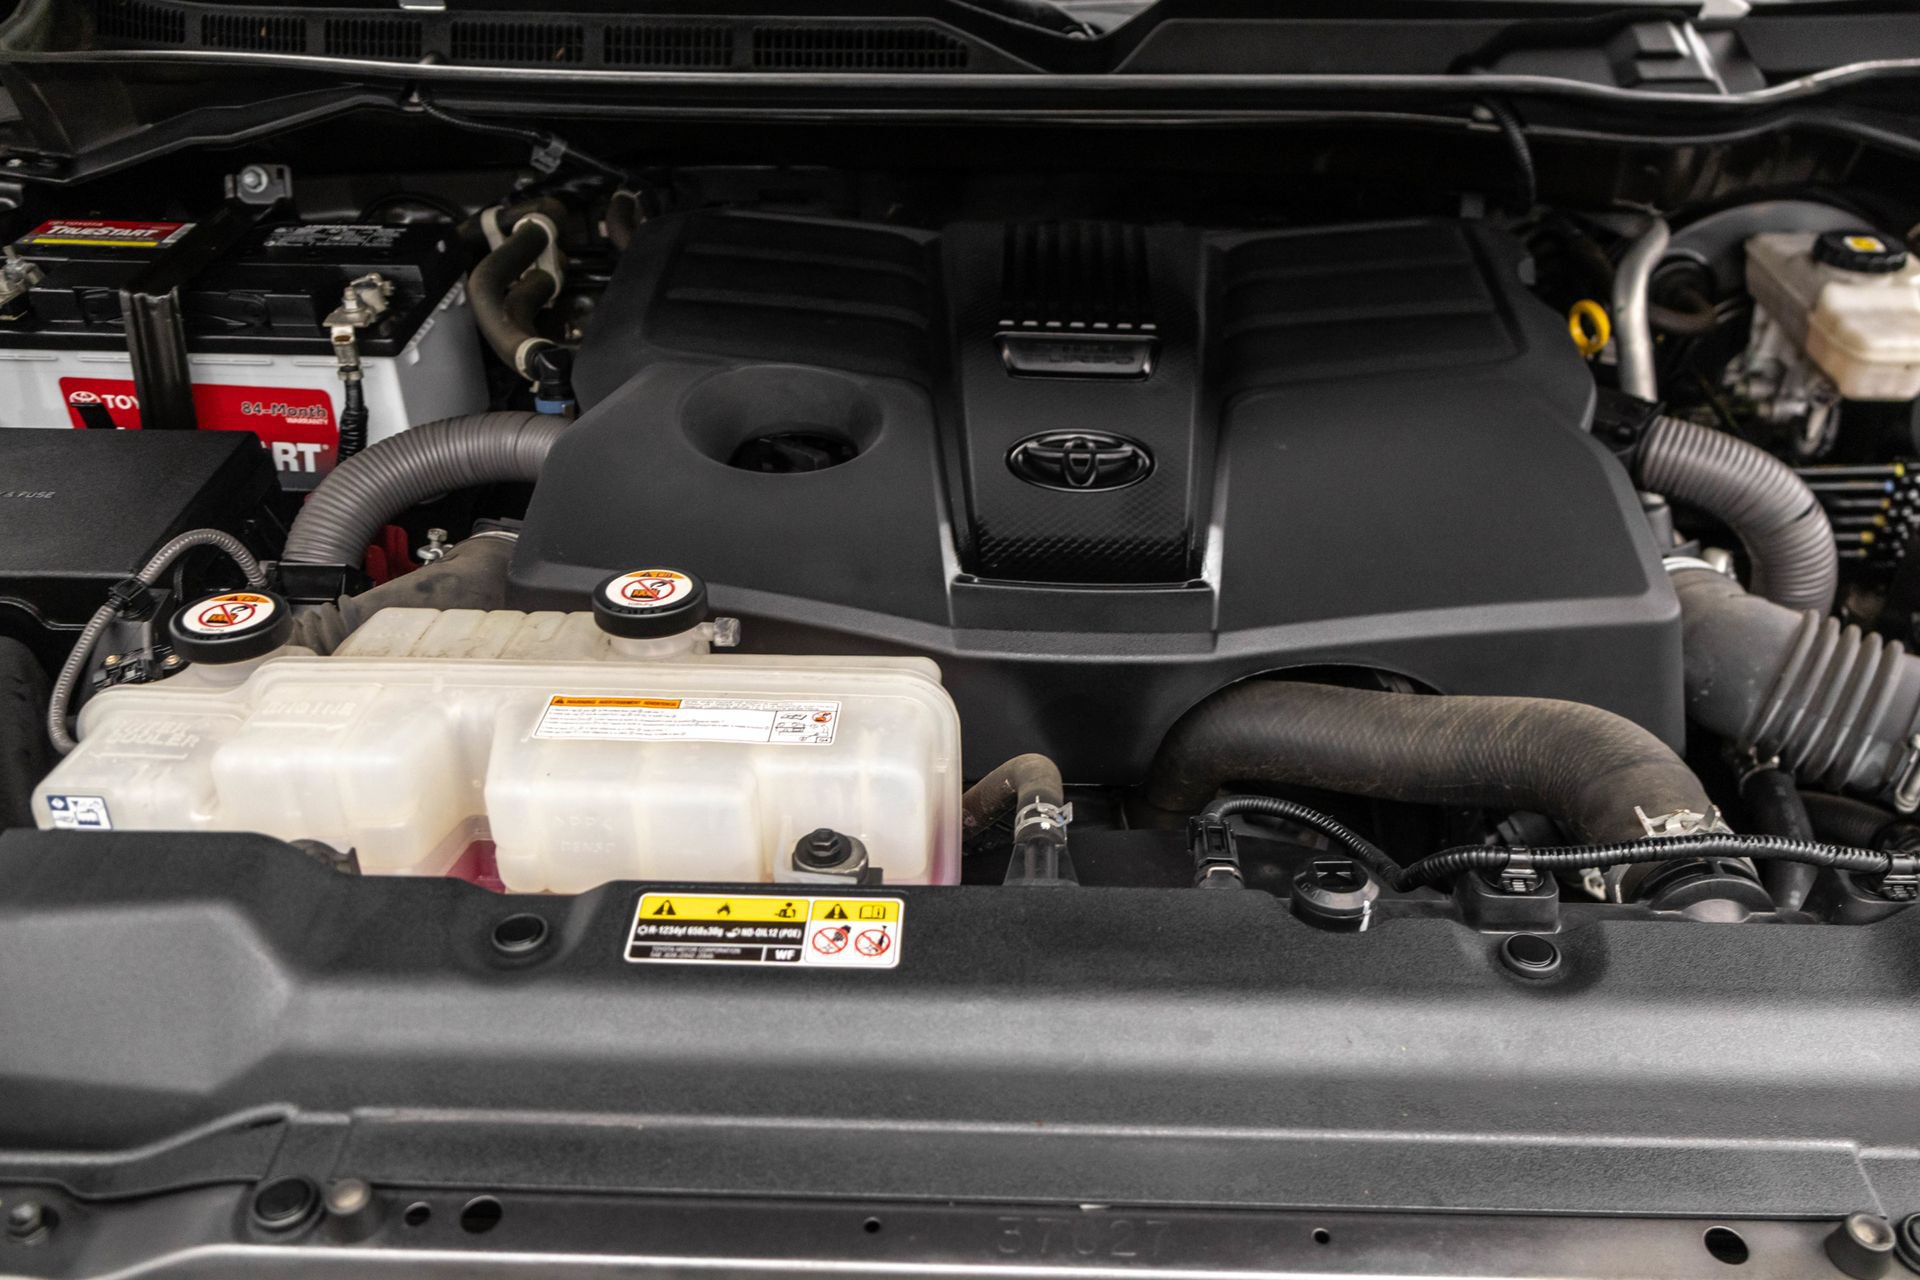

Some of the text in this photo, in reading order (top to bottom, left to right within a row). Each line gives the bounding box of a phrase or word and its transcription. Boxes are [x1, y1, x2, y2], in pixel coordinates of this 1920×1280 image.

[101, 394, 140, 410] TOY
[241, 401, 328, 418] 84-Month
[775, 949, 796, 960] WF
